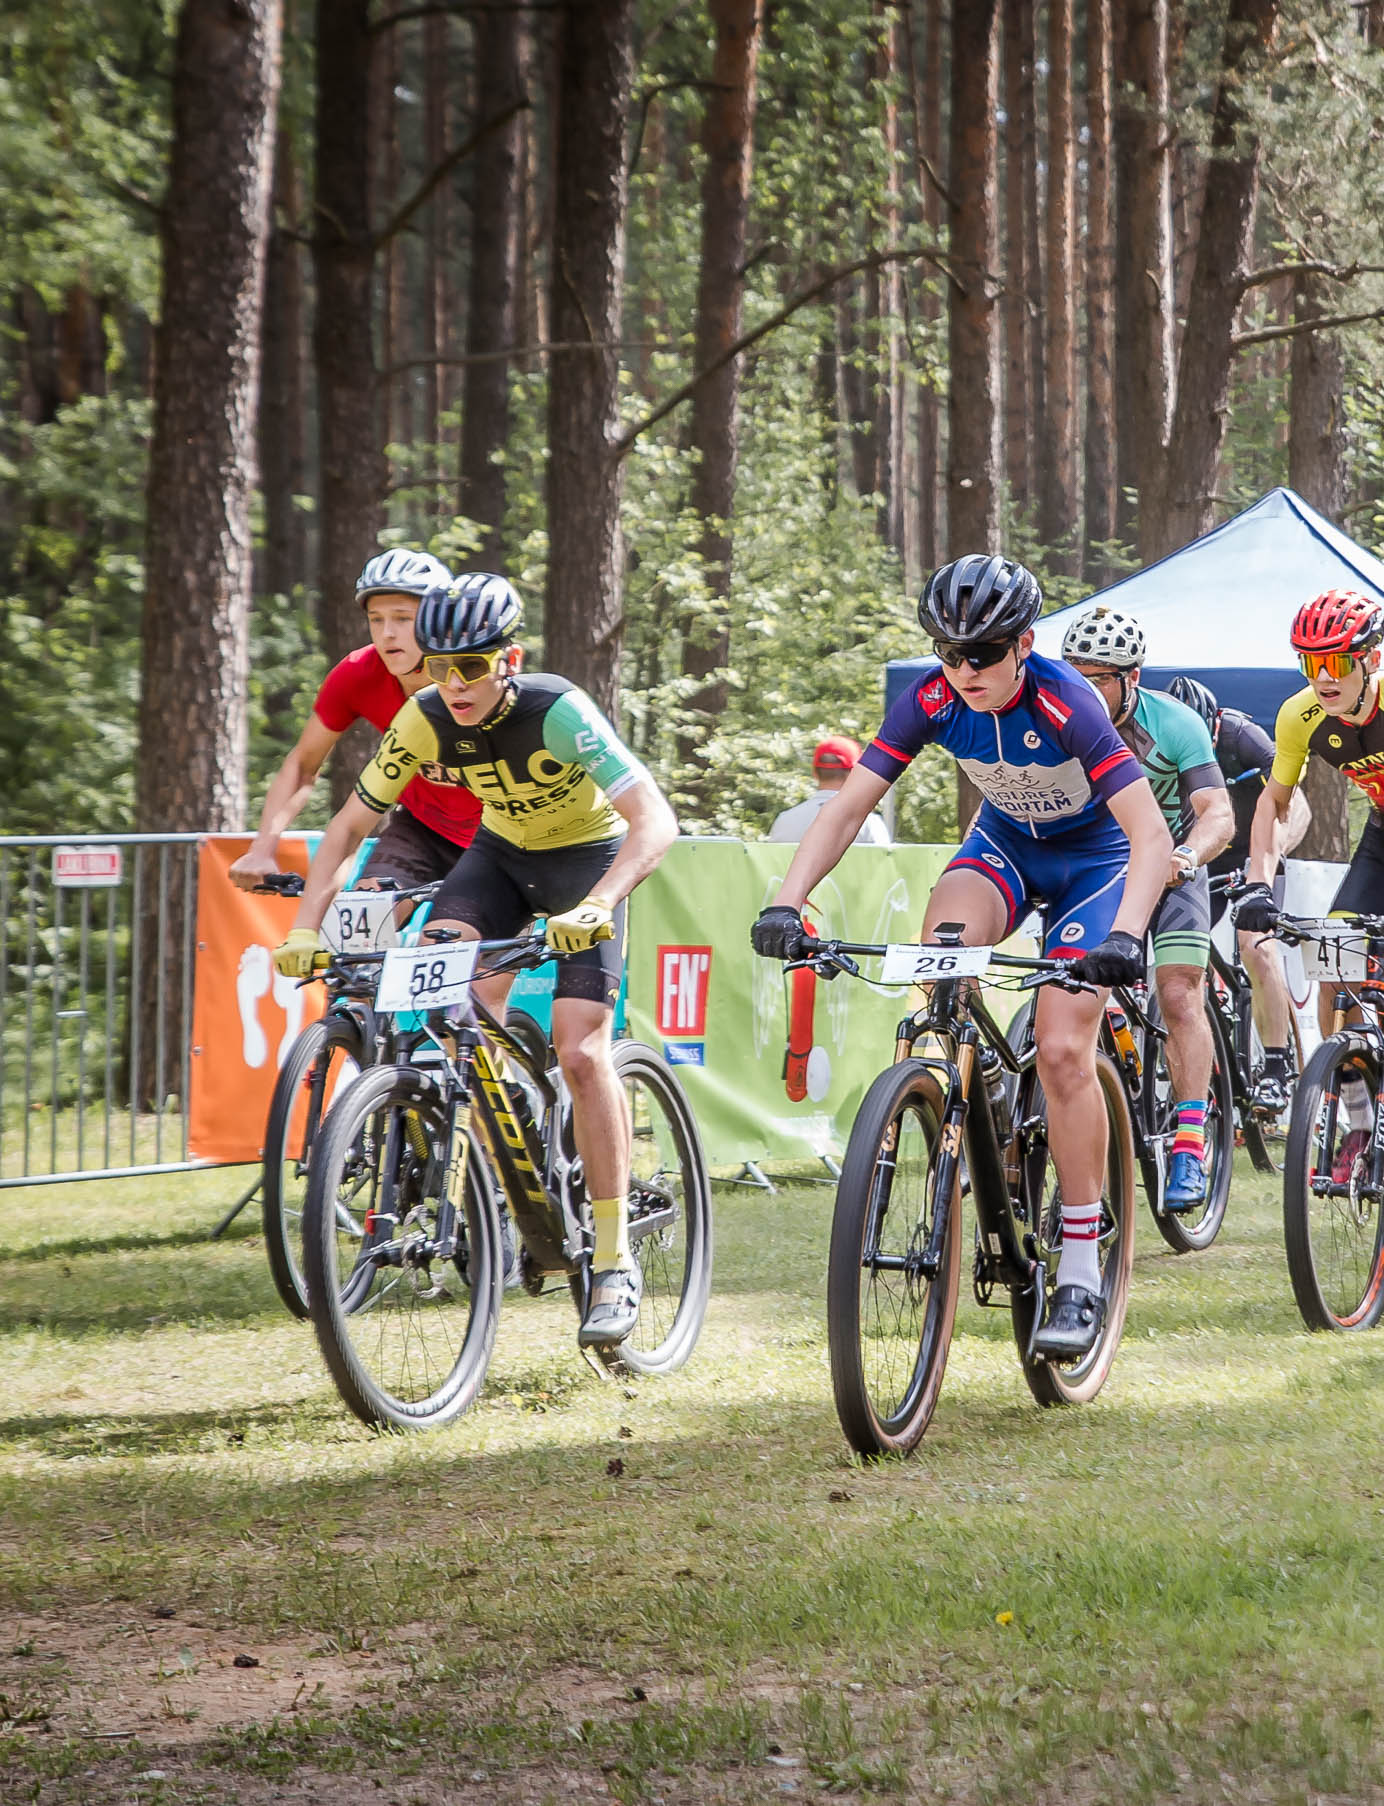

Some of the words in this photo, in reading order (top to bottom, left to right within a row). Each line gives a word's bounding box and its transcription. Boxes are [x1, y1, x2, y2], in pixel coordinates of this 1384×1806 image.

[340, 907, 370, 940] 34
[914, 956, 958, 973] 26
[1318, 935, 1340, 967] 41
[409, 960, 446, 997] 58
